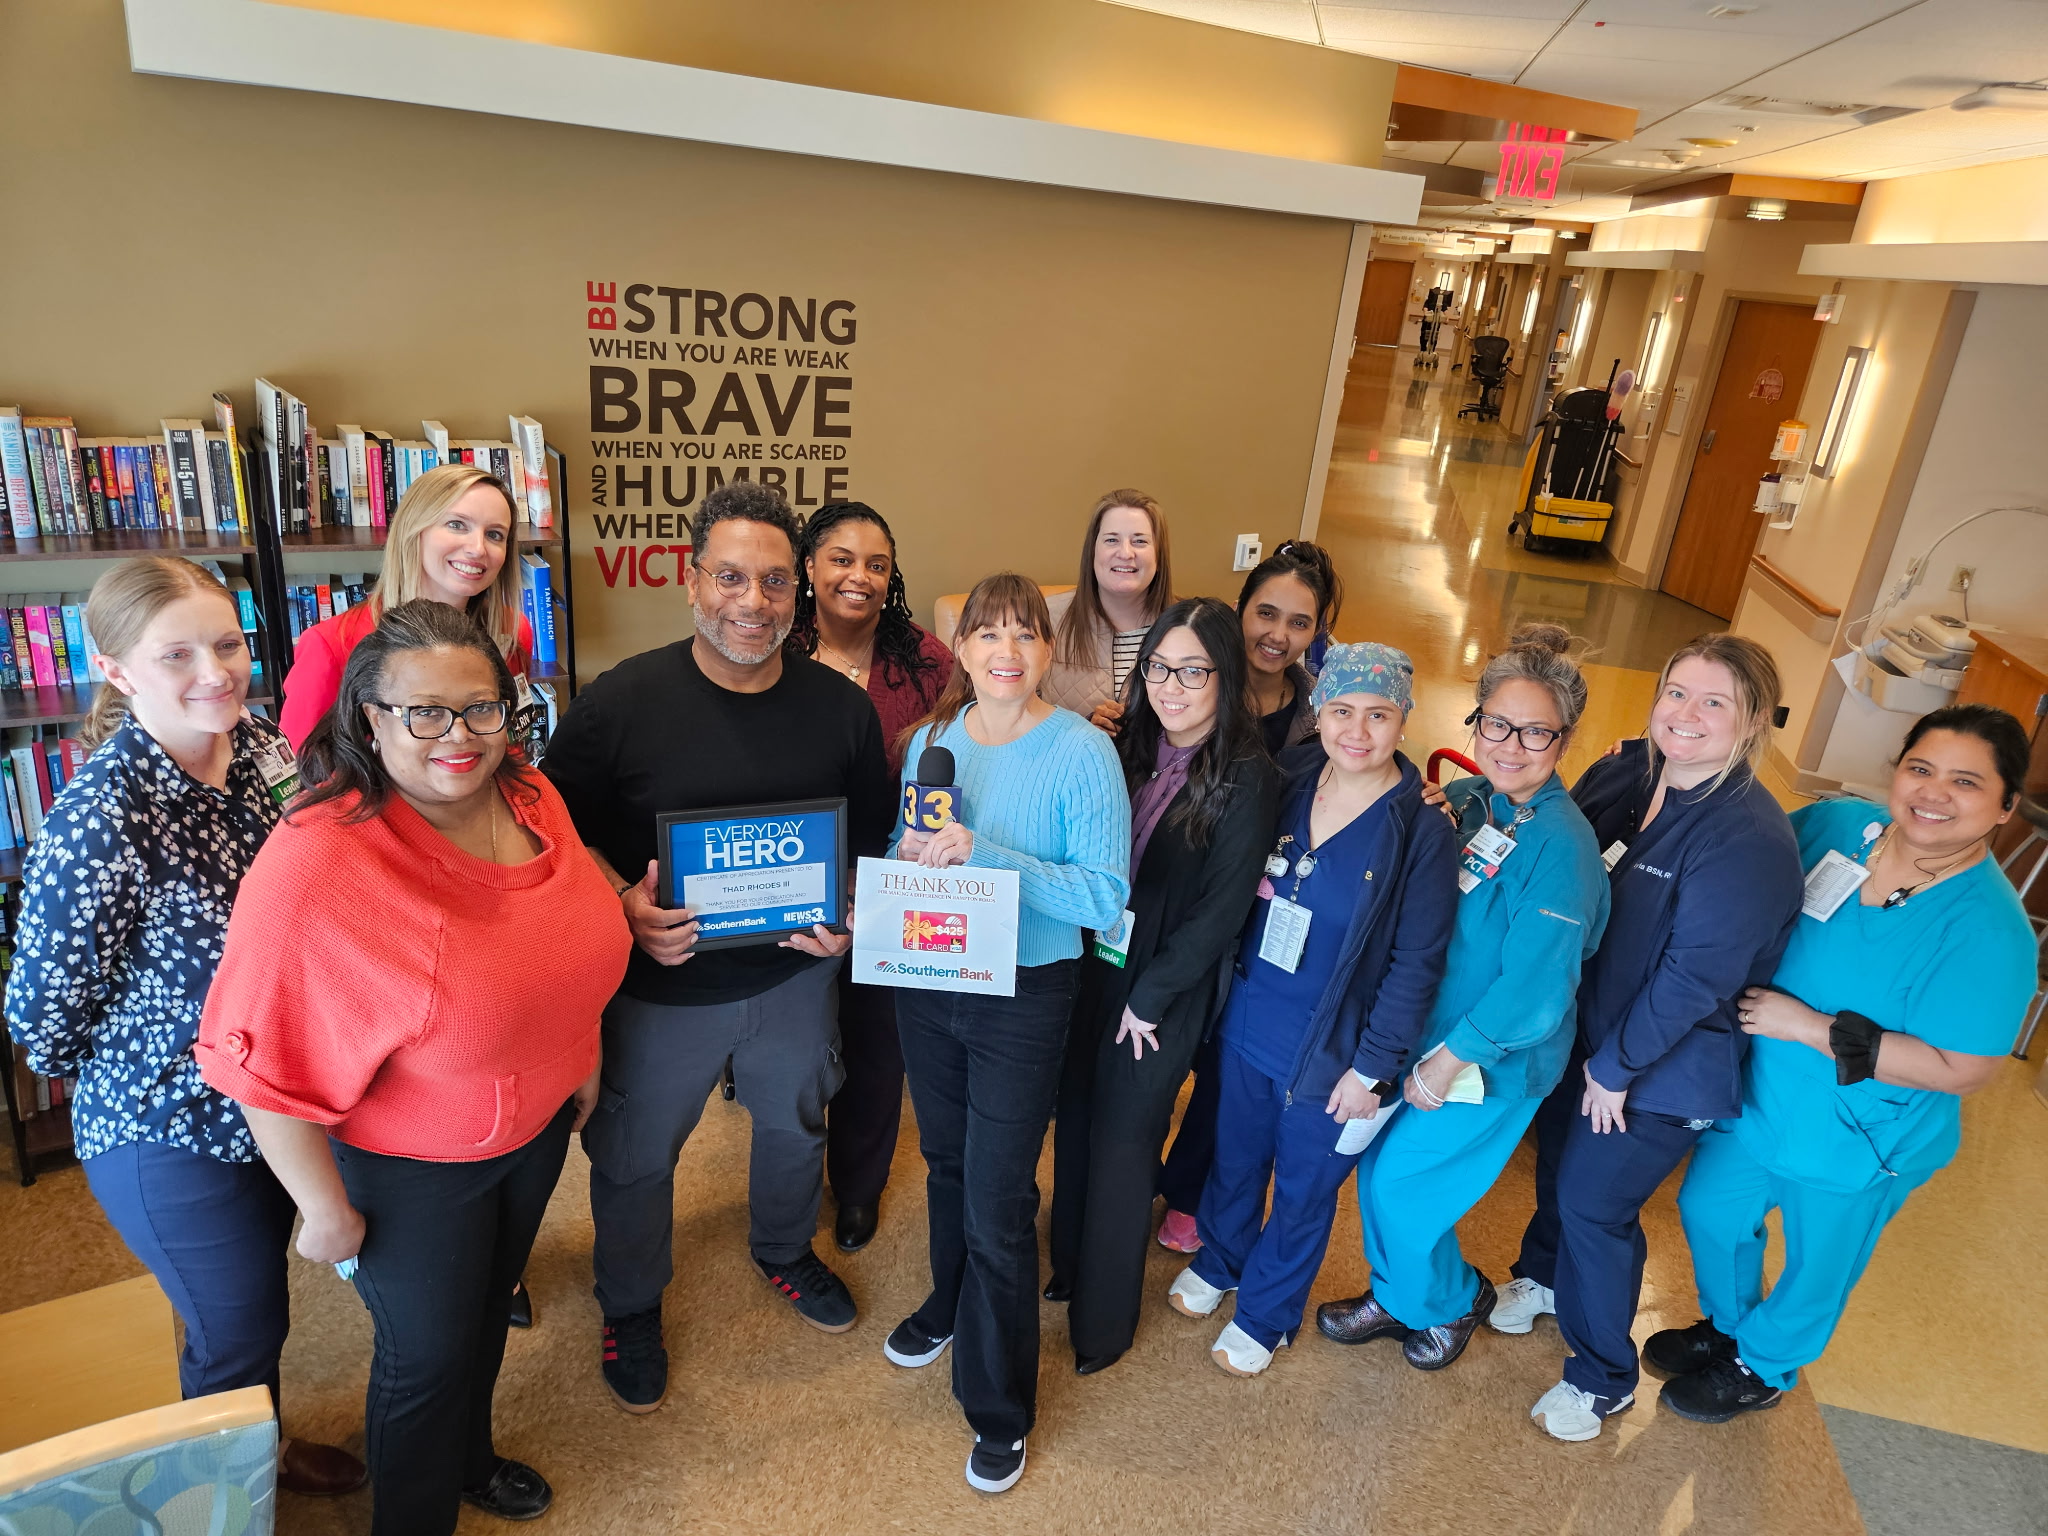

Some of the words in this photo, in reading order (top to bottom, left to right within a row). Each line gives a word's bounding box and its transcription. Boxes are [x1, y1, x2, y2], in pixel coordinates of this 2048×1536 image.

[587, 281, 616, 330] BE
[624, 284, 856, 345] STRONG
[589, 338, 667, 360] WHEN
[675, 343, 725, 364] YOU
[733, 347, 777, 366] ARE
[784, 349, 850, 370] WEAK
[590, 365, 852, 438] BRAVE
[2, 432, 23, 475] SANDFORD
[592, 440, 662, 458] WHEN
[670, 442, 716, 460] YOU
[722, 444, 762, 460] ARE
[770, 444, 846, 460] SCARED
[70, 459, 82, 478] KILL
[179, 457, 190, 470] THE
[177, 471, 194, 479] 5
[10, 478, 28, 498] DEEP
[182, 480, 194, 500] WAVE
[592, 464, 607, 508] AND
[13, 500, 32, 527] FREEZE
[593, 514, 693, 539] WHEN
[594, 544, 693, 588] VICT
[12, 617, 25, 637] DEBRA
[49, 617, 61, 637] DEBRA
[16, 638, 28, 656] WEBB
[54, 639, 66, 656] WEBB
[70, 648, 85, 671] TRUST
[70, 749, 84, 764] TOM
[278, 779, 302, 798] Leade
[904, 786, 916, 826] 3
[922, 790, 953, 830] 3
[704, 820, 804, 844] EVERYDAY
[706, 836, 804, 870] HERO
[696, 874, 728, 882] CERTIFICATE
[738, 870, 774, 878] APPRECIATION
[776, 866, 804, 874] PRESENTED
[1464, 856, 1487, 872] PCT
[1646, 866, 1663, 878] BSN,
[748, 882, 781, 891] RHODES
[881, 874, 950, 894] THANK
[955, 880, 996, 896] YOU
[762, 898, 794, 906] COMMUNITY
[764, 894, 794, 902] DEDICATION
[704, 916, 766, 931] SouthernBank
[784, 910, 812, 923] NEWS
[811, 907, 824, 922] 3
[936, 924, 964, 936] $425
[906, 942, 924, 950] GIFT
[926, 944, 949, 952] CARD
[1098, 948, 1120, 964] Leader
[898, 963, 994, 982] SouthernBank
